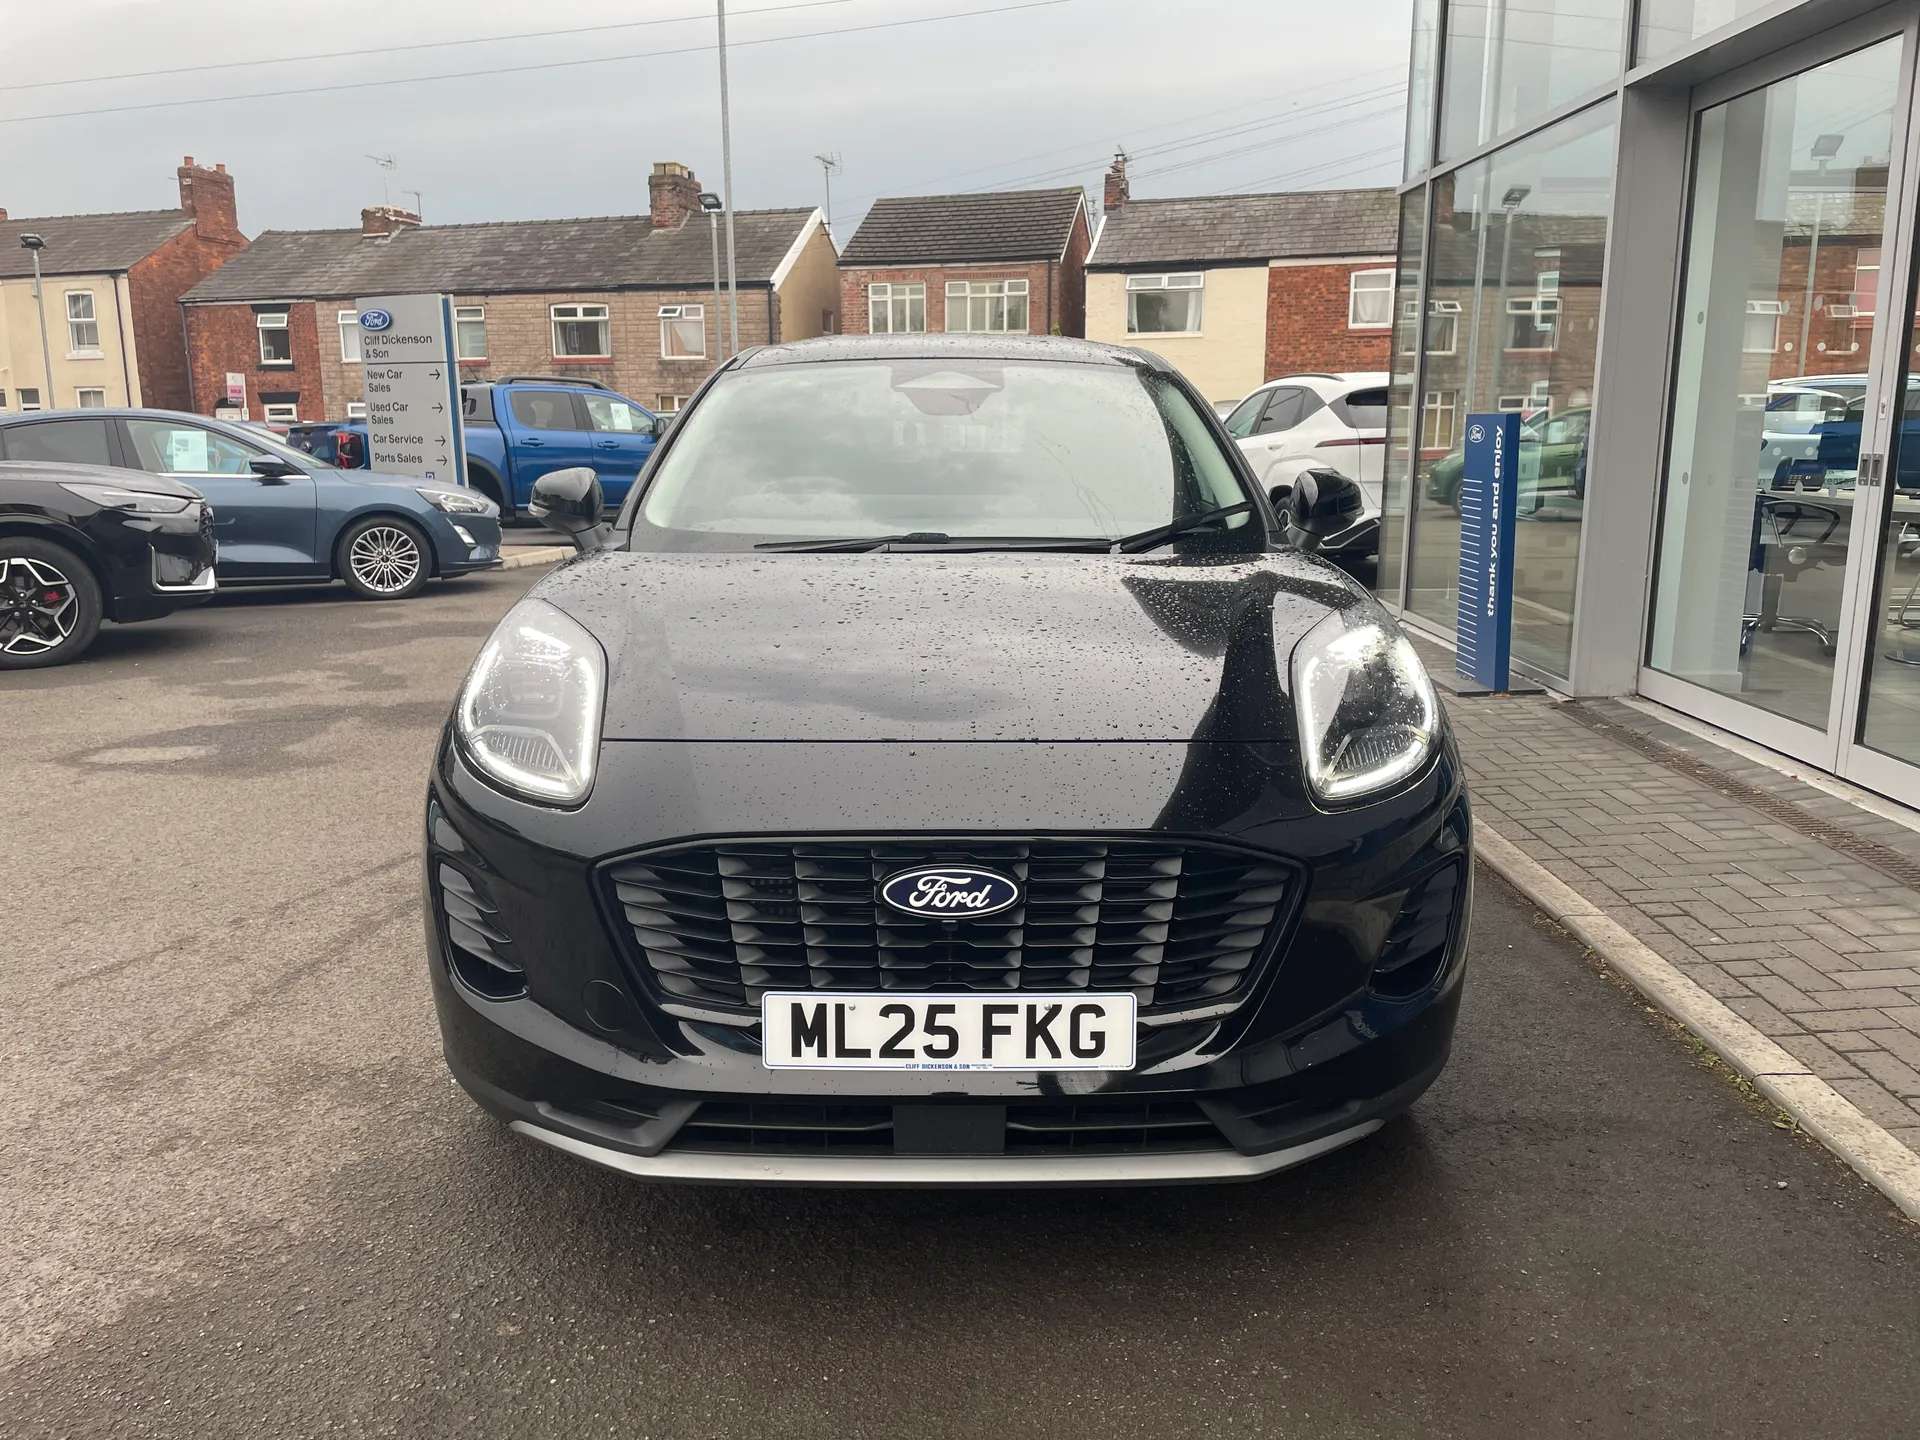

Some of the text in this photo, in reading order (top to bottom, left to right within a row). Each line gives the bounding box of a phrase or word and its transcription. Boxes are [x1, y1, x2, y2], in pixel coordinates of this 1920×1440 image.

[364, 334, 433, 346] Cliff Dickenson
[365, 348, 389, 358] & Son
[367, 369, 402, 380] New Car
[368, 382, 391, 393] Sales
[370, 402, 409, 412] Used Car
[371, 415, 394, 425] Sales
[373, 433, 424, 444] Car Service
[374, 453, 423, 464] Parts Sales
[1487, 425, 1504, 617] thank you and enjoy
[909, 875, 992, 907] Ford
[790, 1002, 1107, 1060] ML25 FKG
